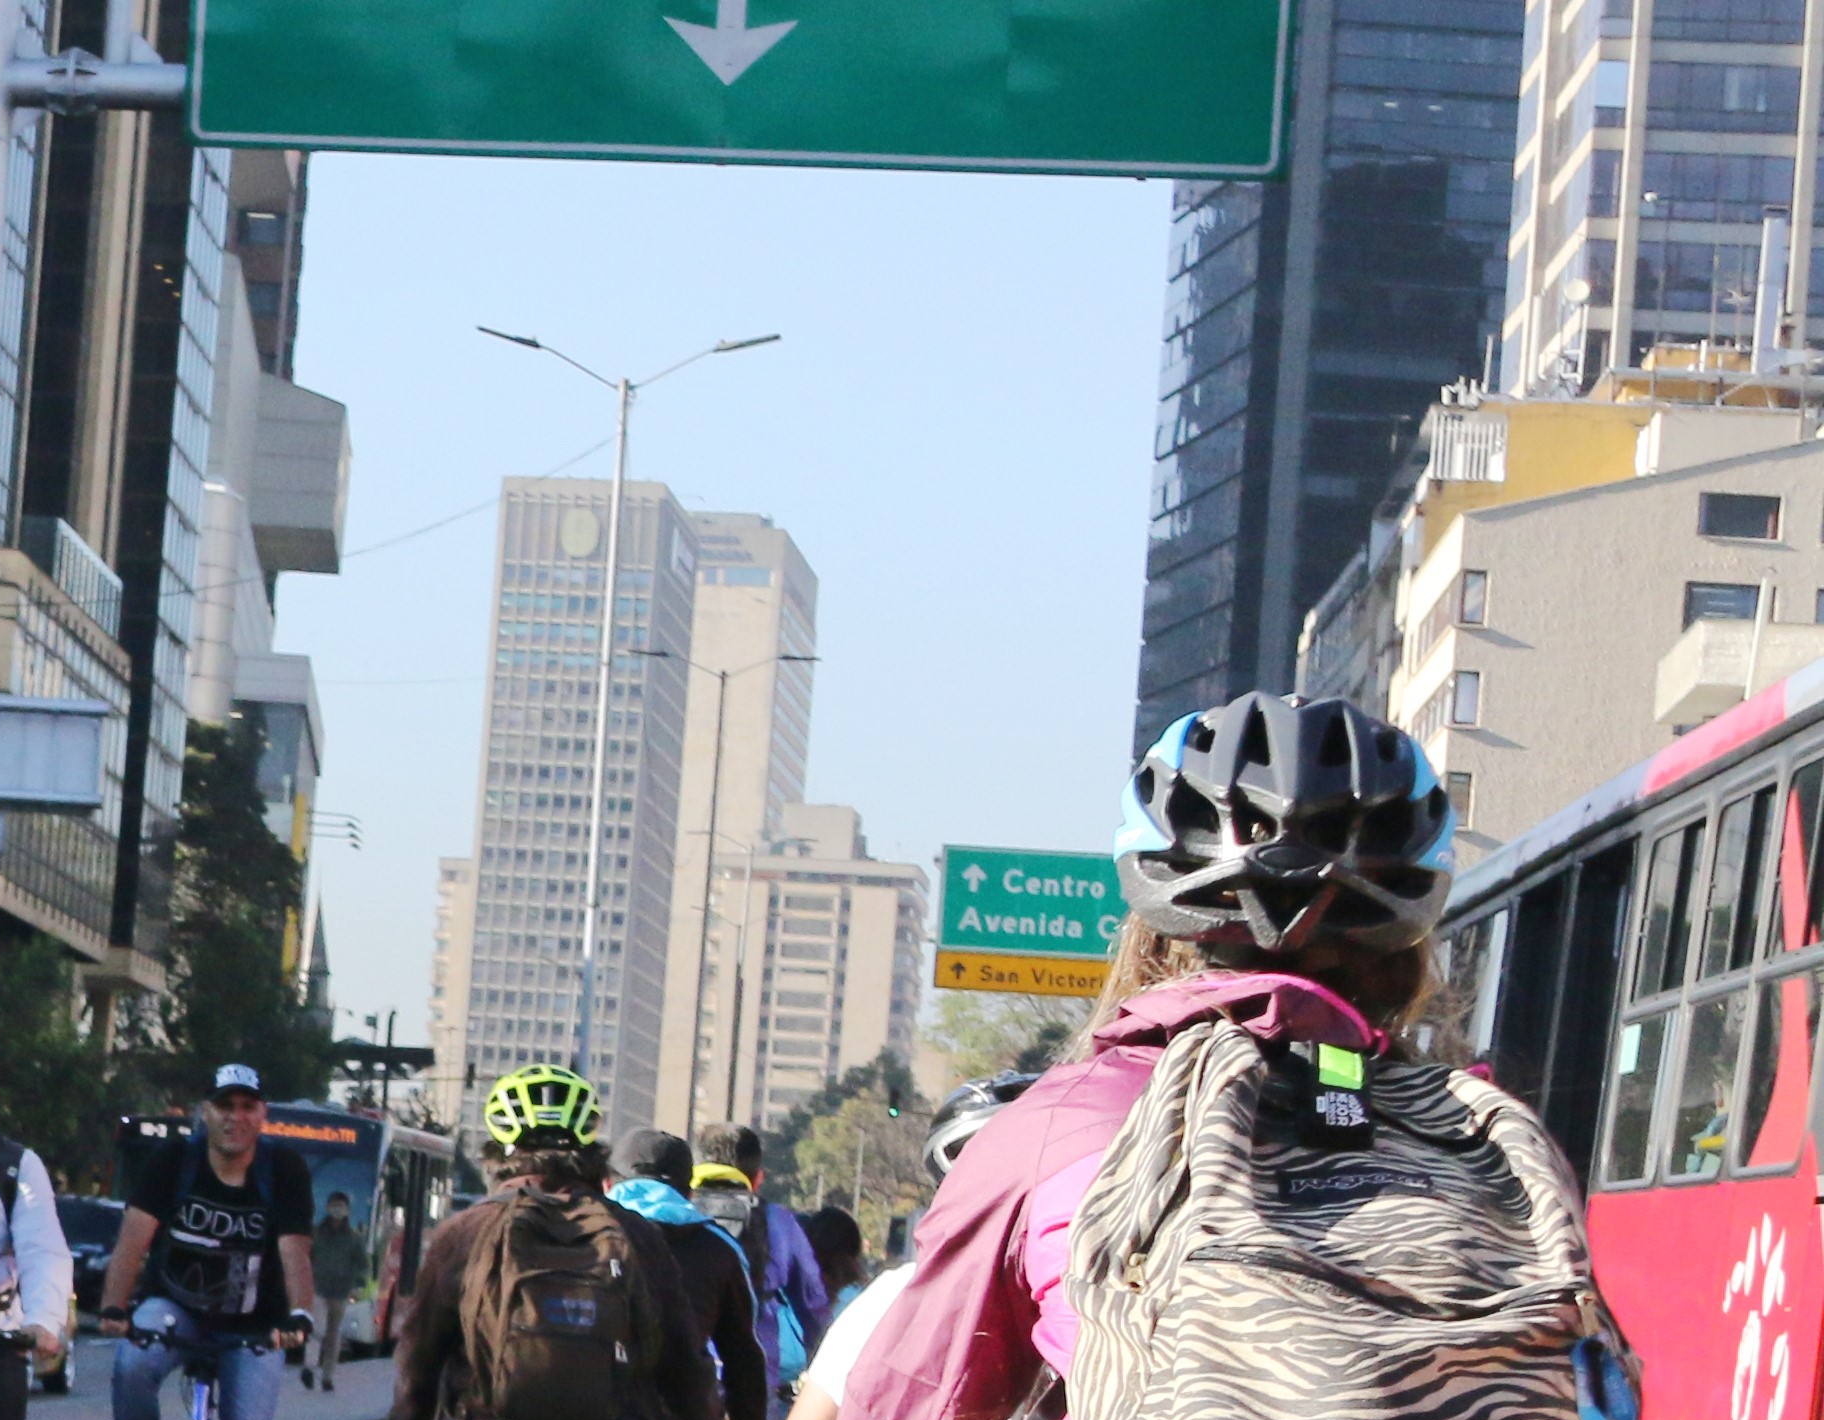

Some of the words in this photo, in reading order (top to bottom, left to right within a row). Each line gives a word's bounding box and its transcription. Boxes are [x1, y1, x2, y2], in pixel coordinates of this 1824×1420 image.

[1003, 868, 1105, 899] Centro
[958, 905, 1083, 939] Avenida
[980, 965, 1019, 984] San
